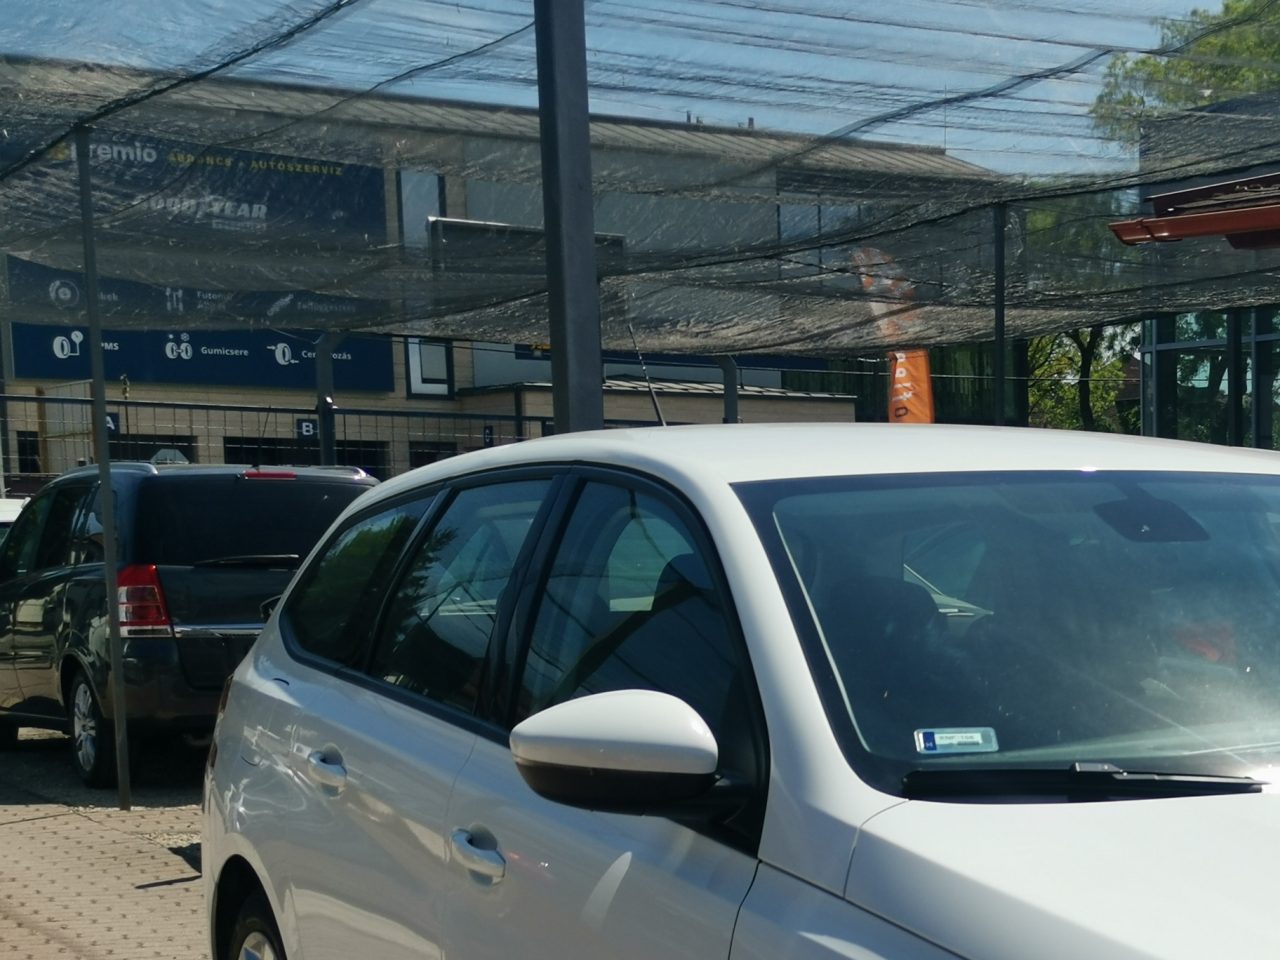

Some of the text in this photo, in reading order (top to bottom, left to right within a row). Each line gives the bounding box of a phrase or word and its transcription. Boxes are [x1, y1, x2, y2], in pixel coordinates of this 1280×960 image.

[201, 346, 249, 357] Gumicsere
[105, 415, 116, 430] A
[302, 422, 314, 436] B
